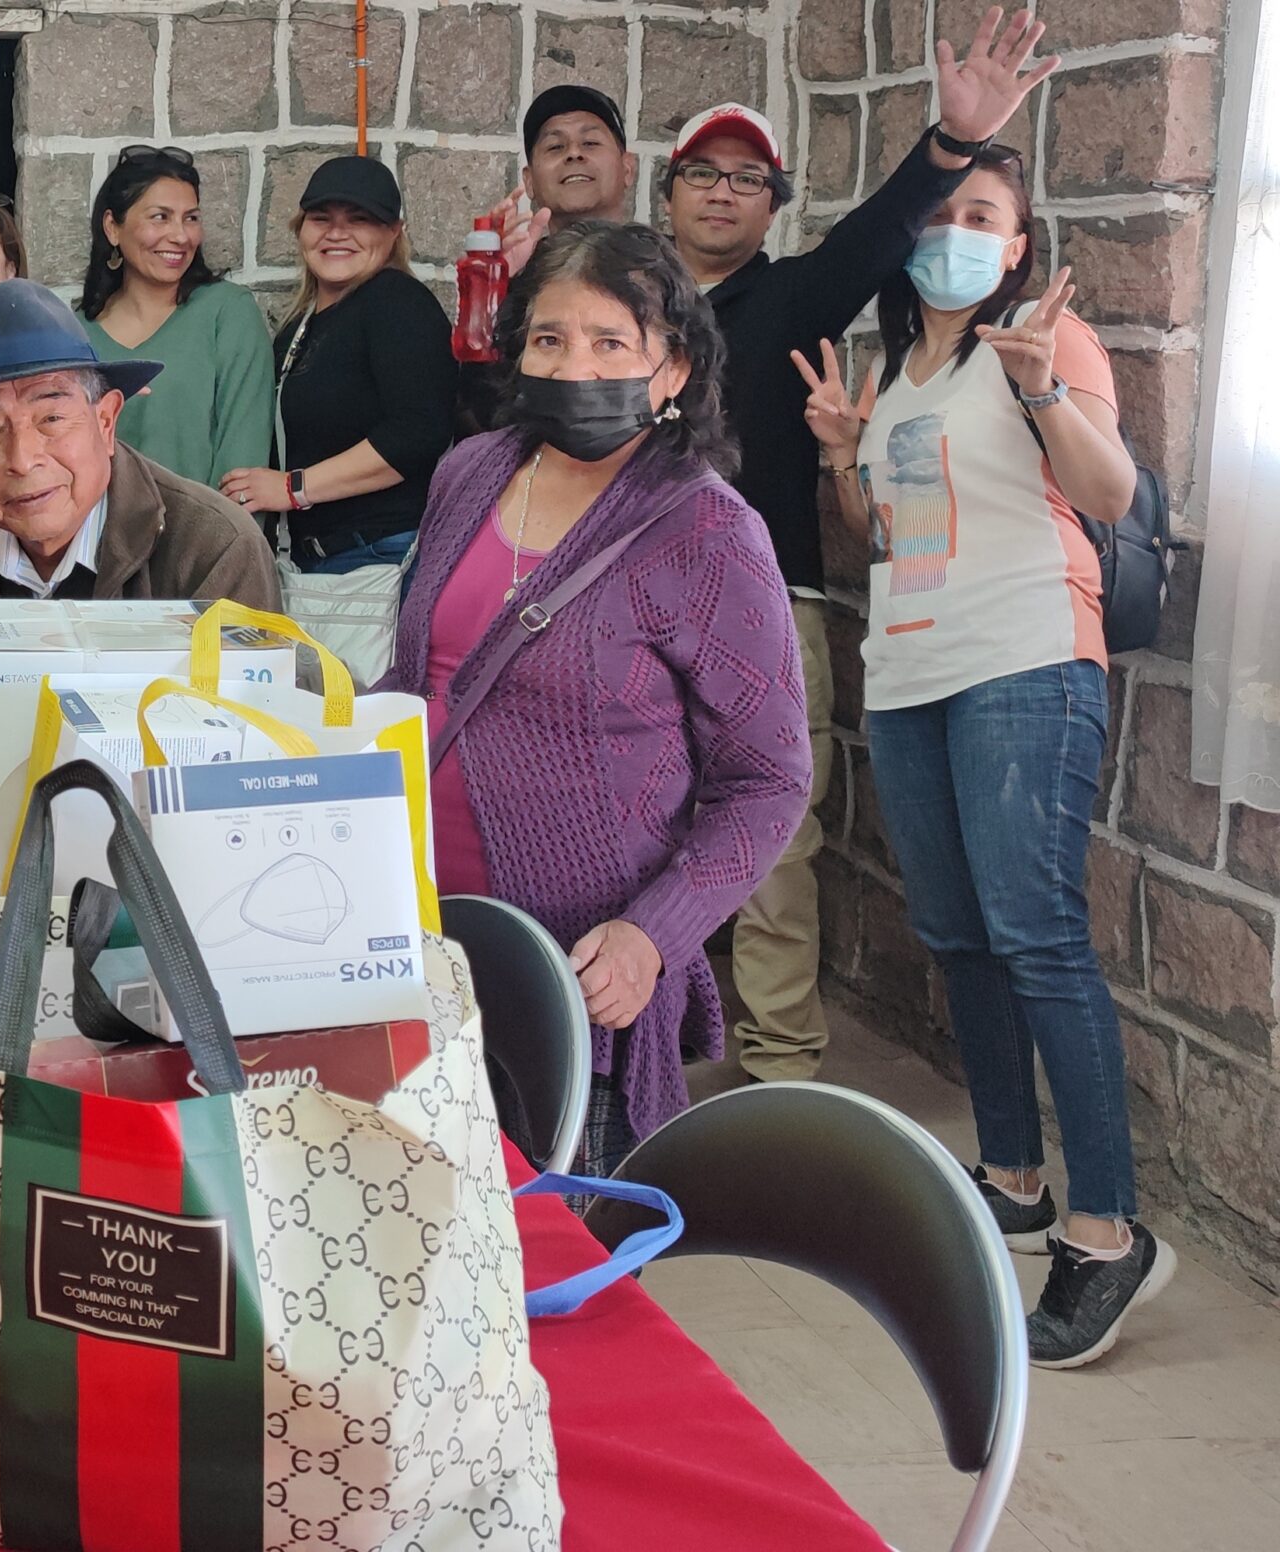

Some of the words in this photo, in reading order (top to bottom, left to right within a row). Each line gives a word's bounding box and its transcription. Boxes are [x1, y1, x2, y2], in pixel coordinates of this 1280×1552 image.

[371, 938, 394, 950] PCS
[396, 936, 407, 948] 10
[242, 975, 271, 985] MASK
[274, 970, 336, 982] PROTECTIVE
[339, 957, 414, 982] KN95
[187, 1066, 319, 1096] Sremo
[86, 1215, 174, 1253] THANK
[101, 1247, 157, 1277] YOU
[90, 1274, 116, 1289] FOR
[118, 1279, 154, 1296] YOUR
[62, 1285, 127, 1308] COMMING
[130, 1299, 144, 1311] IN
[145, 1301, 181, 1317] THAT
[75, 1303, 136, 1326] SPEACIAL
[138, 1317, 165, 1330] DAY
